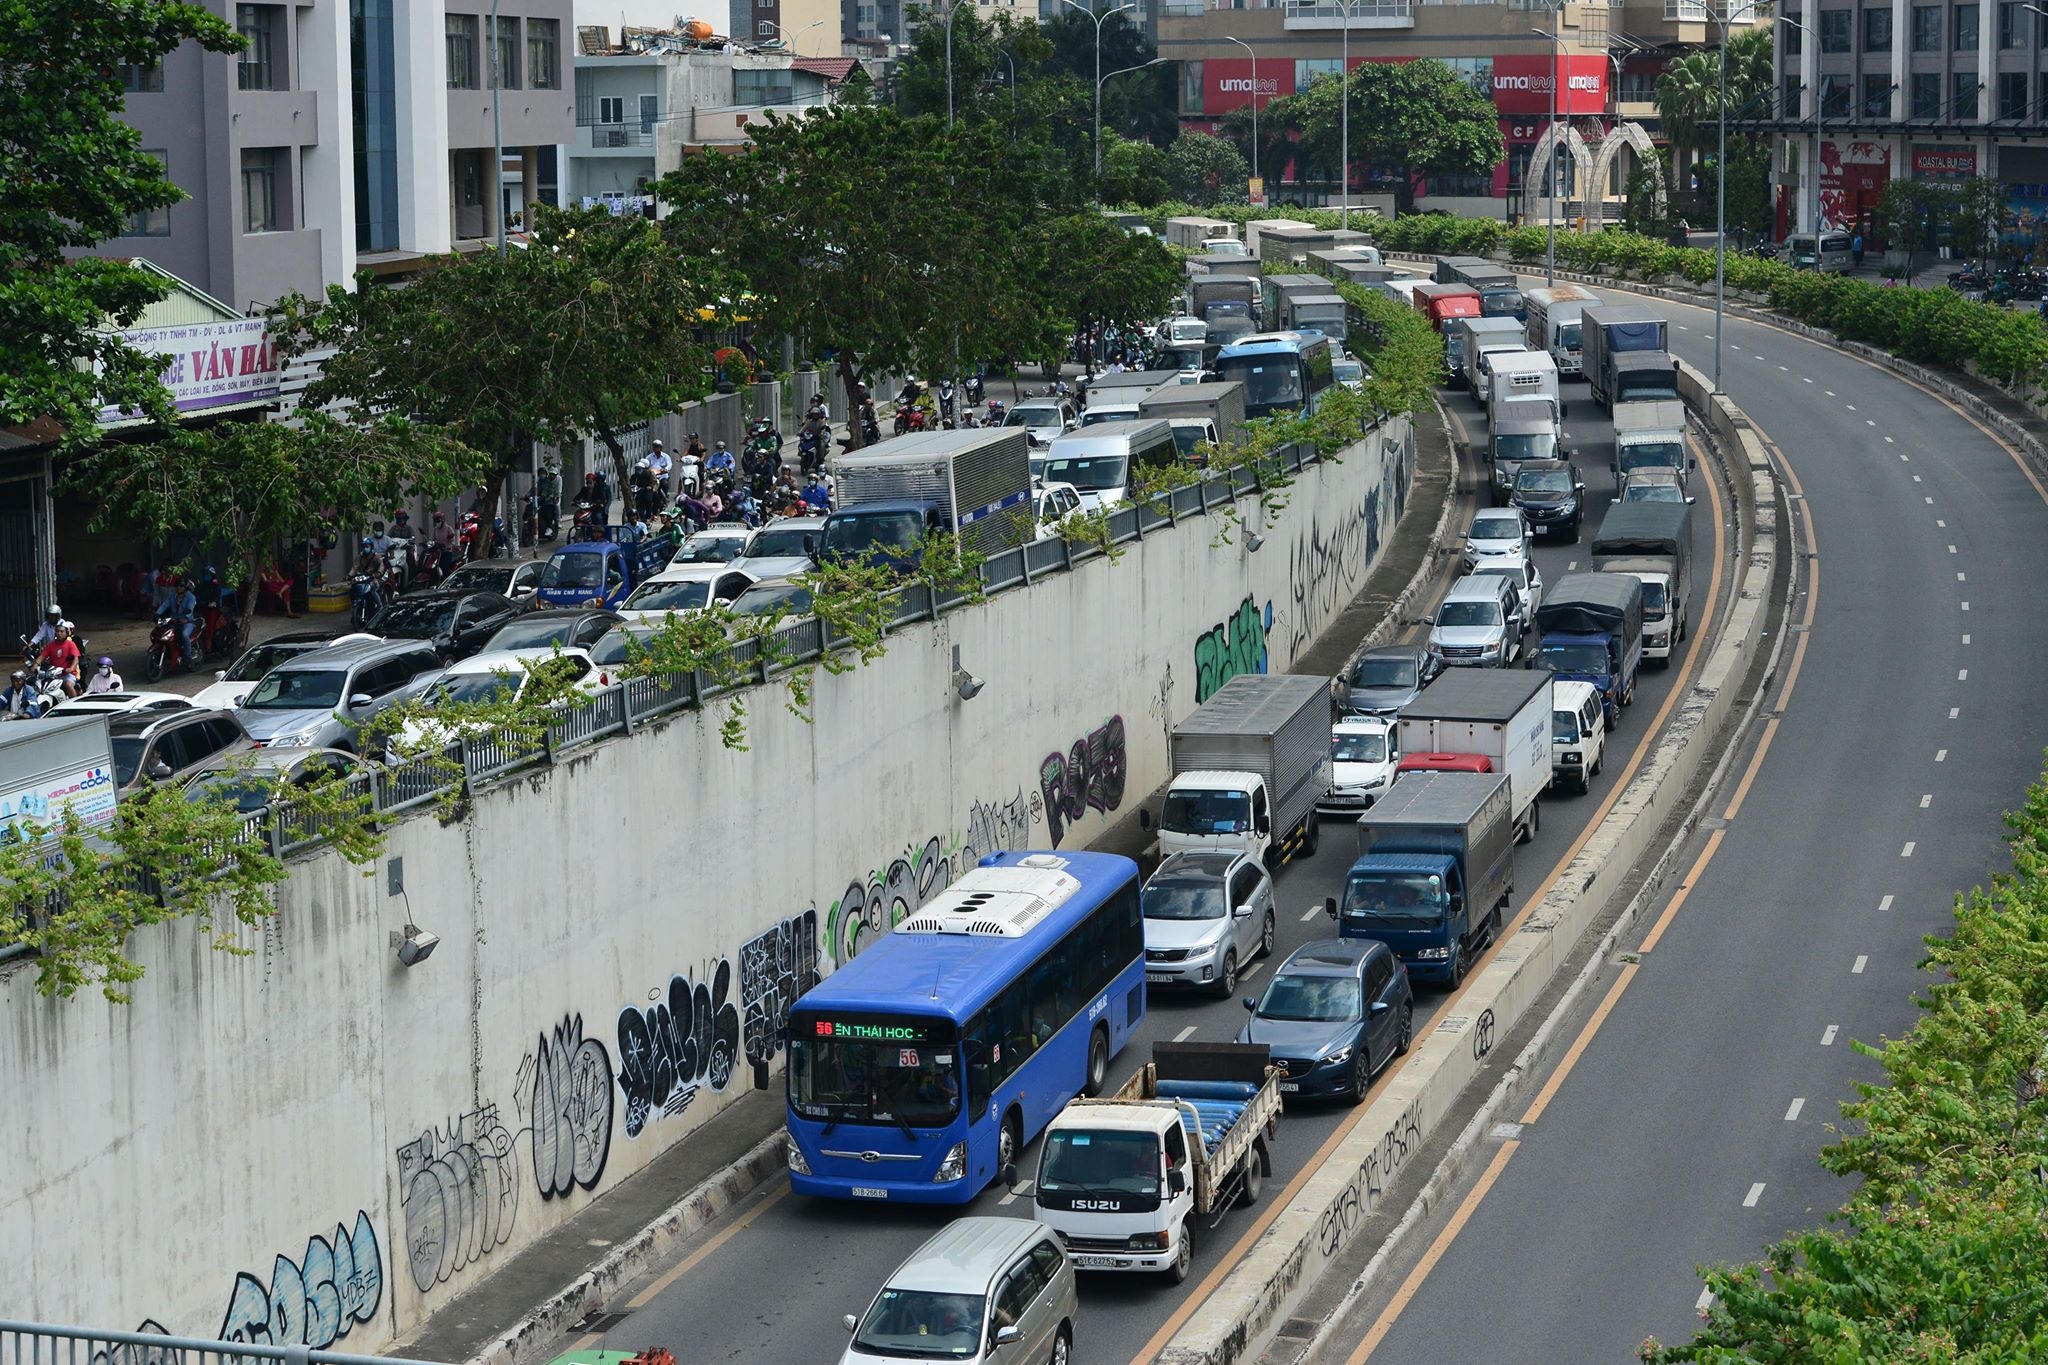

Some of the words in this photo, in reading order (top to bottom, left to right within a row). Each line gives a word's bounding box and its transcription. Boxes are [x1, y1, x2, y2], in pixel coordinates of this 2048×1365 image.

[1494, 76, 1528, 90] uma
[160, 331, 168, 340] TY
[169, 330, 187, 339] TNHH
[189, 328, 198, 338] TM
[234, 324, 243, 333] VT
[191, 340, 237, 382] VĂN
[816, 1021, 833, 1036] 56
[854, 1025, 882, 1038] THÁI
[900, 1050, 918, 1066] 56
[1071, 1199, 1120, 1210] ISUZU
